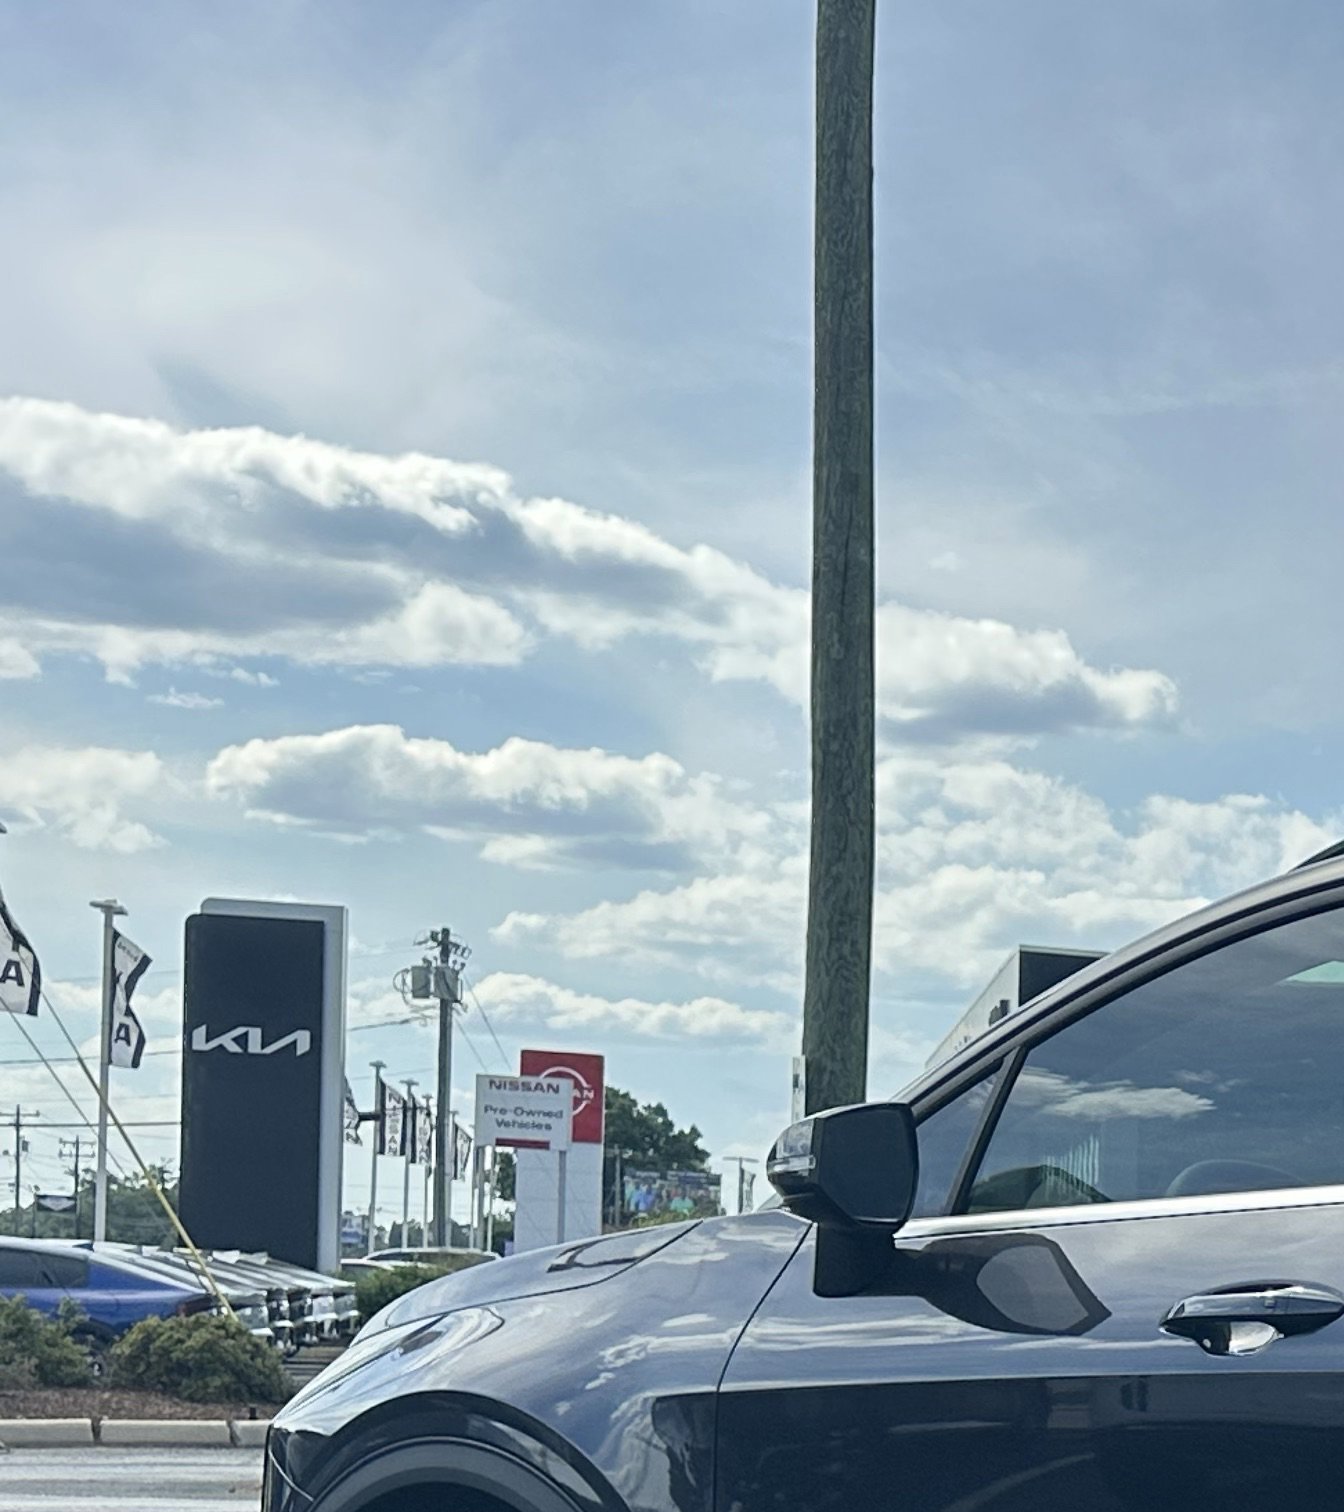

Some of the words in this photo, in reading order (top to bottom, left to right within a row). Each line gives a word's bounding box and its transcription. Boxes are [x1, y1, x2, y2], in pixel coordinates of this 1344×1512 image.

[191, 1023, 311, 1057] KIA
[488, 1080, 560, 1095] NISSAN
[483, 1103, 564, 1119] Pre-Owned
[495, 1118, 552, 1131] Vehicles
